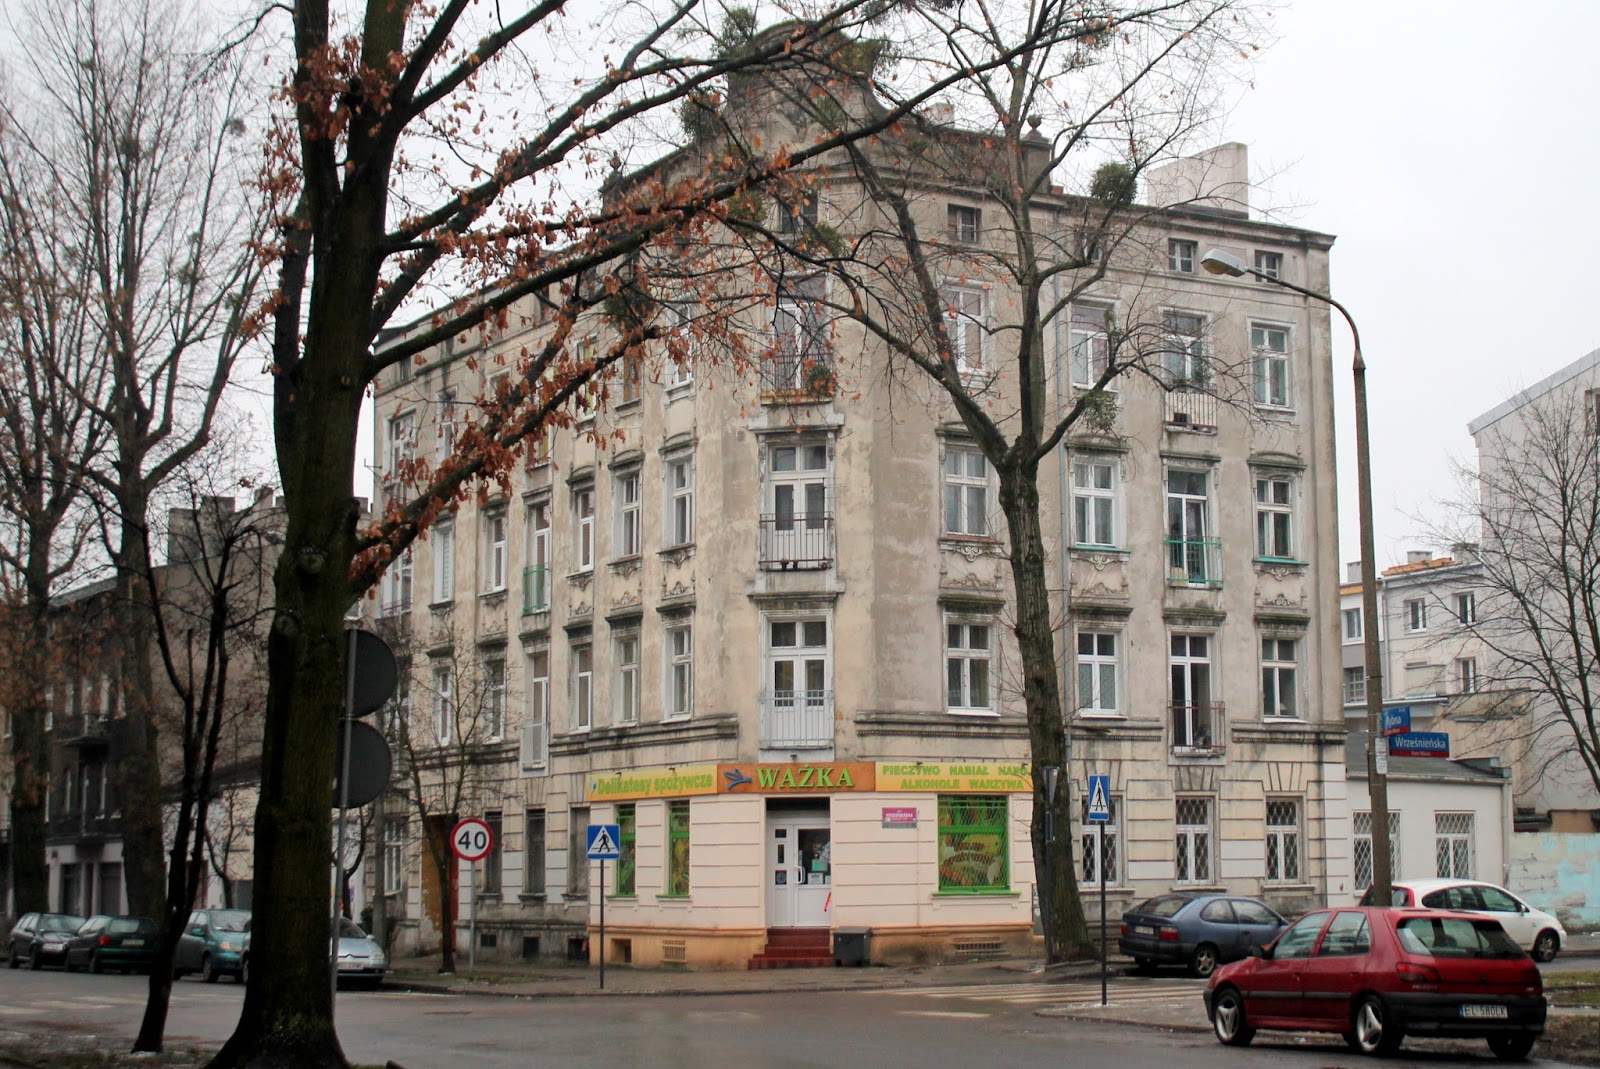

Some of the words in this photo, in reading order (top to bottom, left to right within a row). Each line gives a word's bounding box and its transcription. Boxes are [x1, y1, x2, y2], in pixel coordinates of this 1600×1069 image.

[1395, 736, 1446, 748] Wrześnieńska
[756, 763, 854, 789] WAŻKA
[882, 765, 941, 776] PIECZYWO
[950, 765, 989, 776] NABIAŁ
[597, 777, 652, 796] Delikatesy
[901, 778, 960, 790] ALKOHOLE
[968, 778, 1024, 790] WARZYWA
[458, 830, 487, 850] 40
